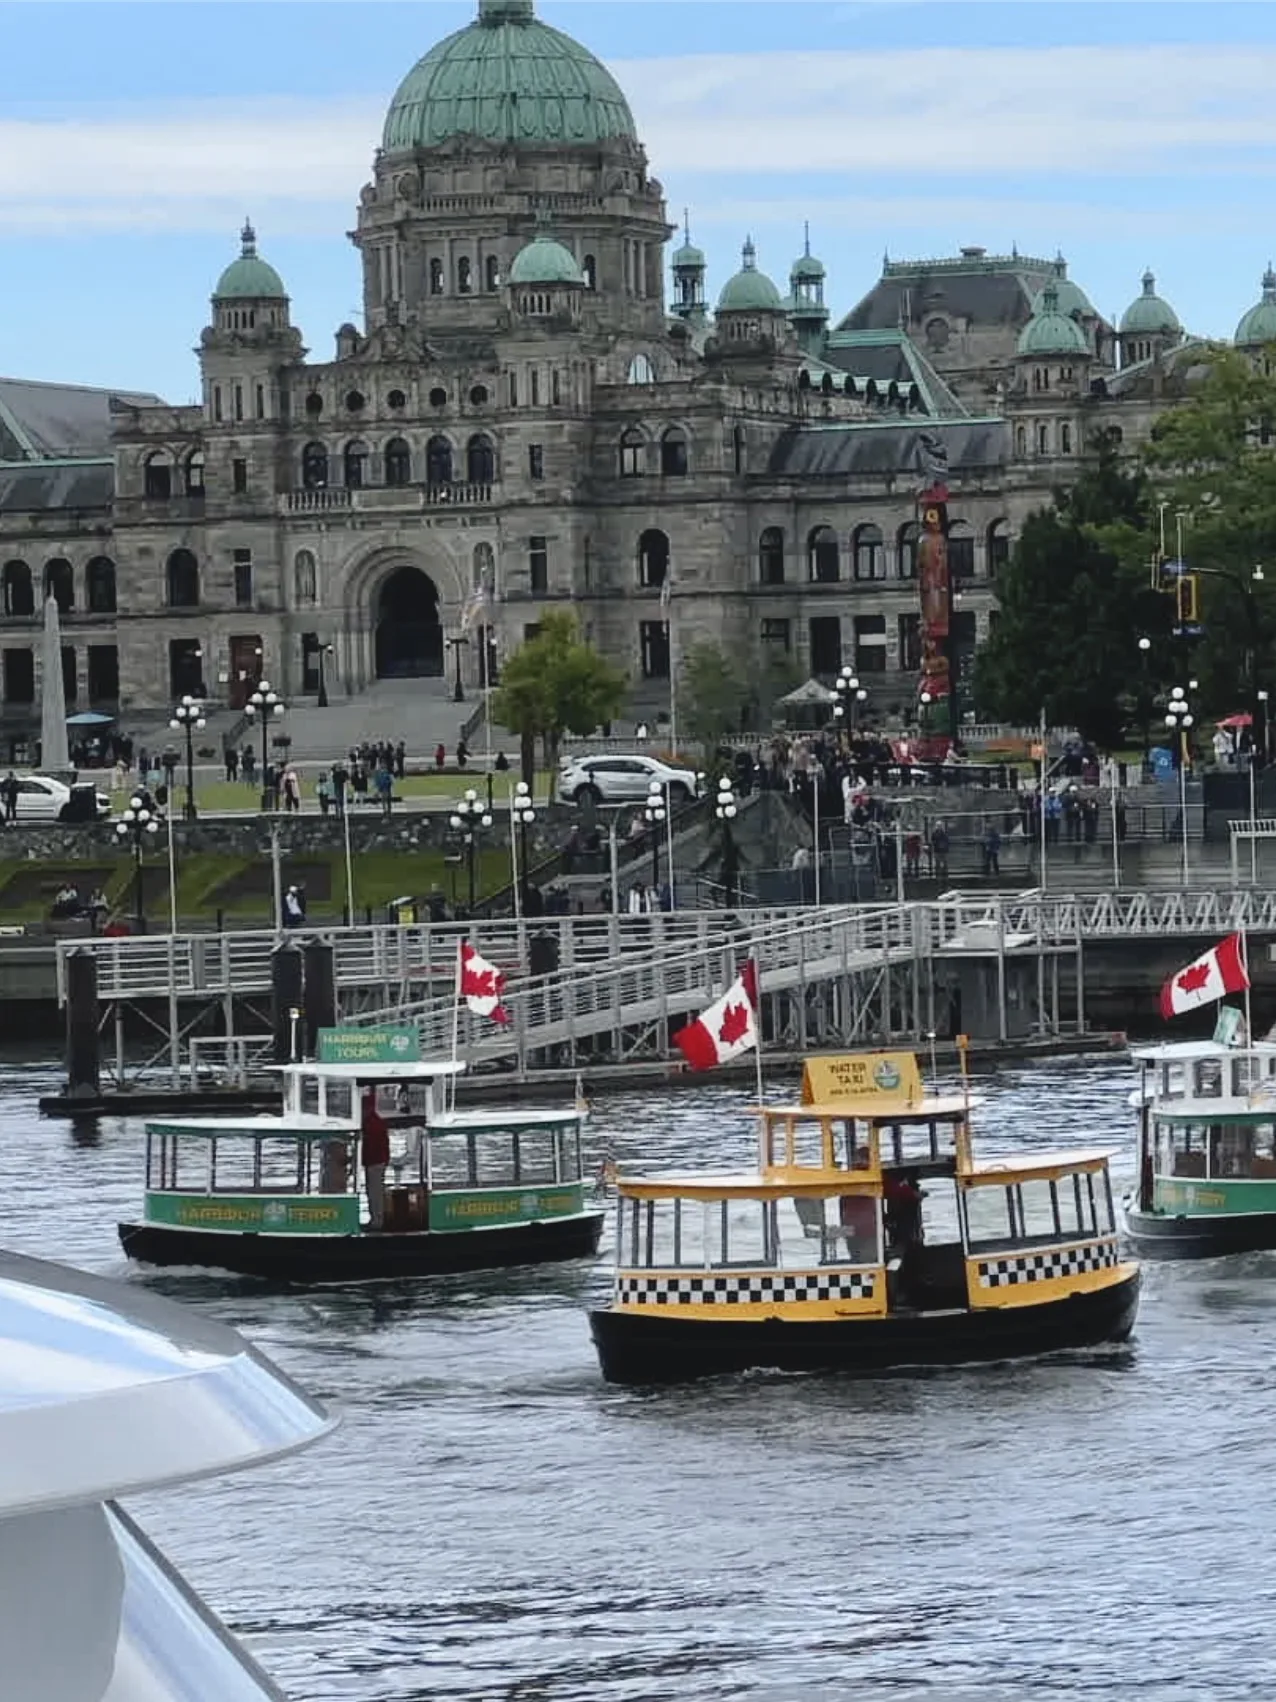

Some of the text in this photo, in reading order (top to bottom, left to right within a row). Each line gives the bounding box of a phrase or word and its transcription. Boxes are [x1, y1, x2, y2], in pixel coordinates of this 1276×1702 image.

[323, 1033, 388, 1044] HARBOUR
[336, 1046, 378, 1058] TOURS
[828, 1062, 867, 1074] WATER
[837, 1074, 865, 1085] TAXI
